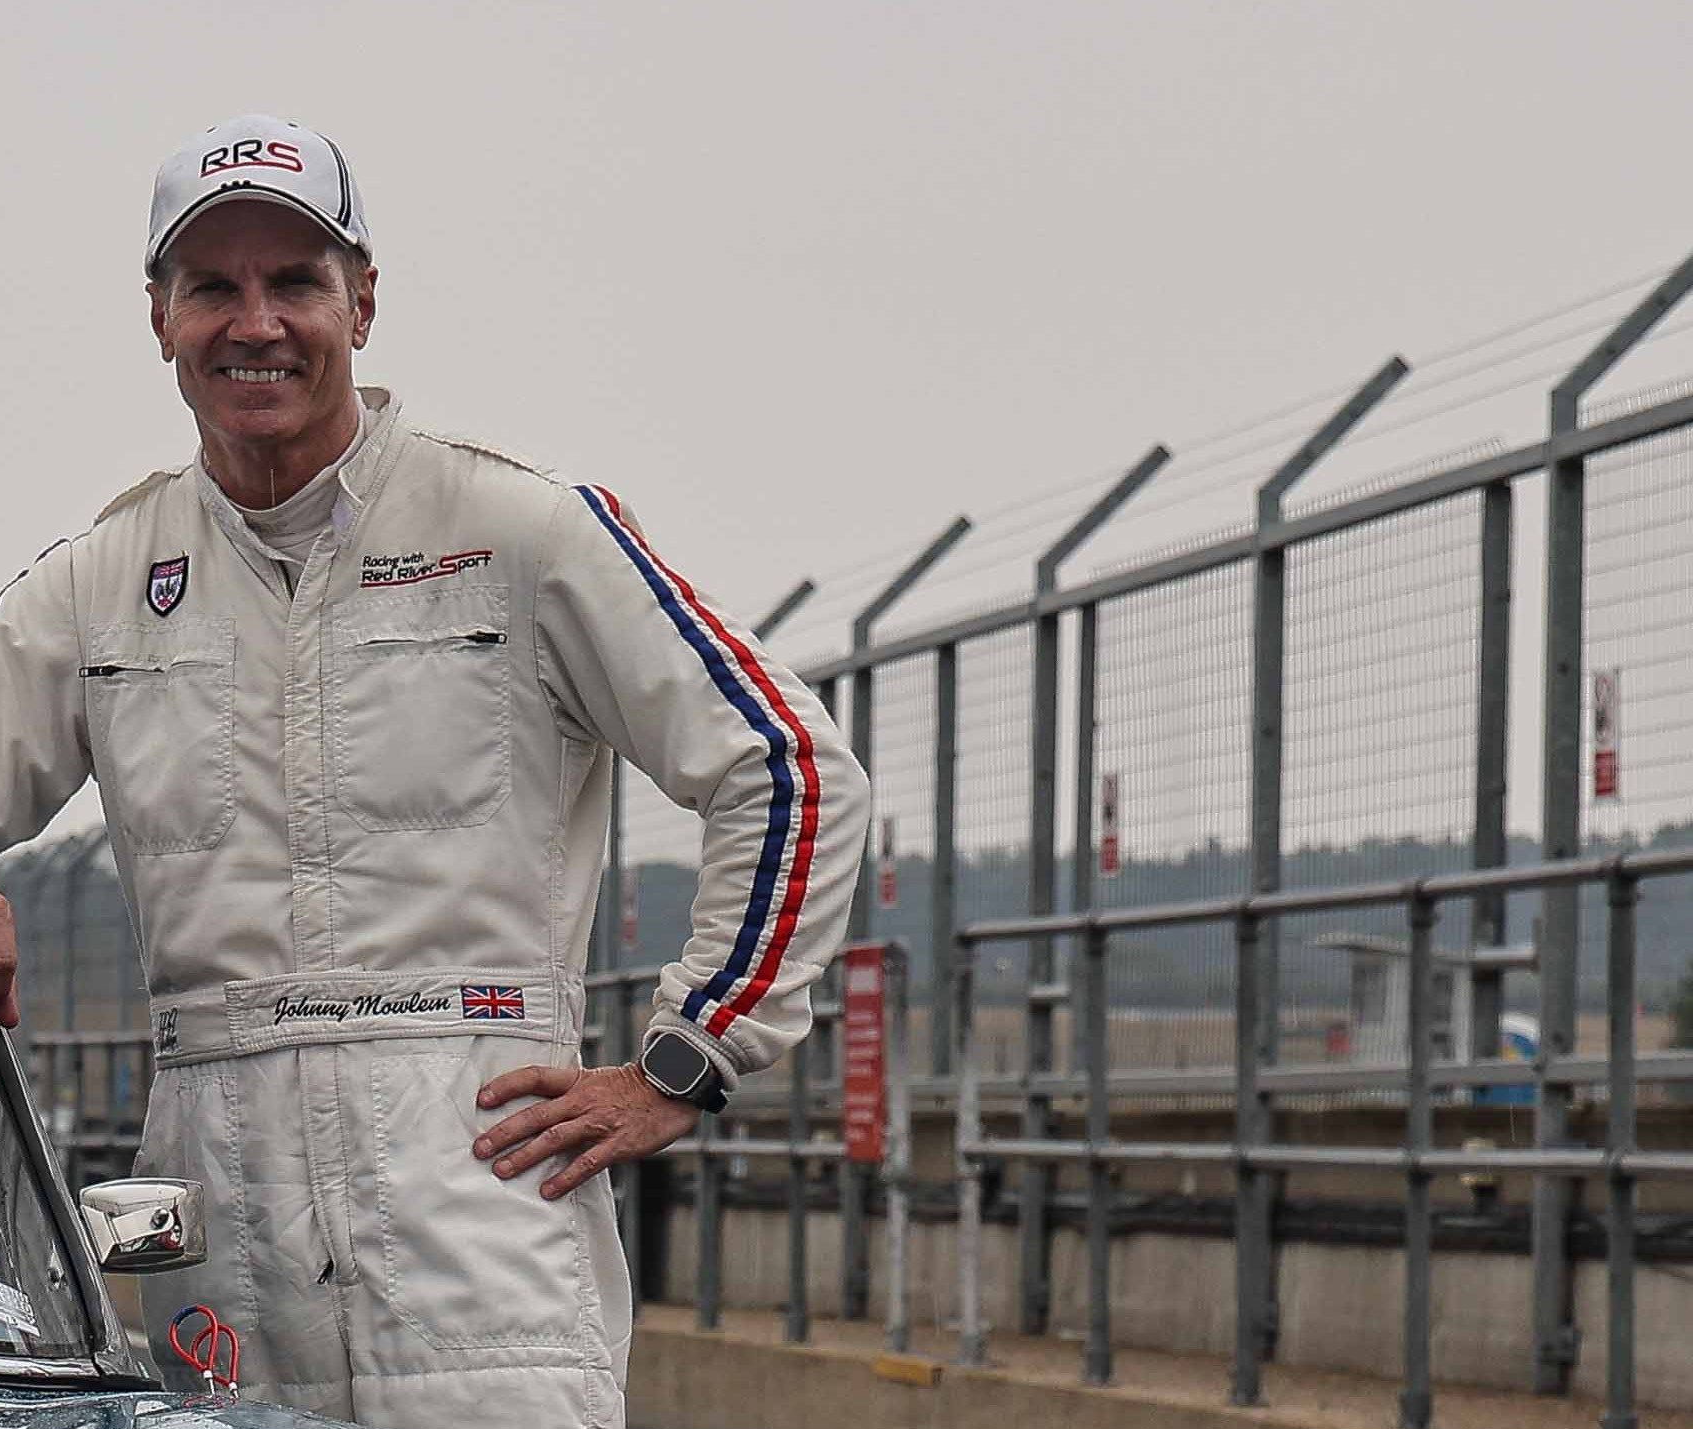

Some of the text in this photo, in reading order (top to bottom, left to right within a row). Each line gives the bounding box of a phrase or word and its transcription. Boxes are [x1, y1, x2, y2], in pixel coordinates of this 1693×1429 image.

[200, 138, 304, 178] RRS
[362, 552, 424, 569] Racing with
[362, 550, 493, 582] Red River Sport
[273, 996, 350, 1026] Johnny
